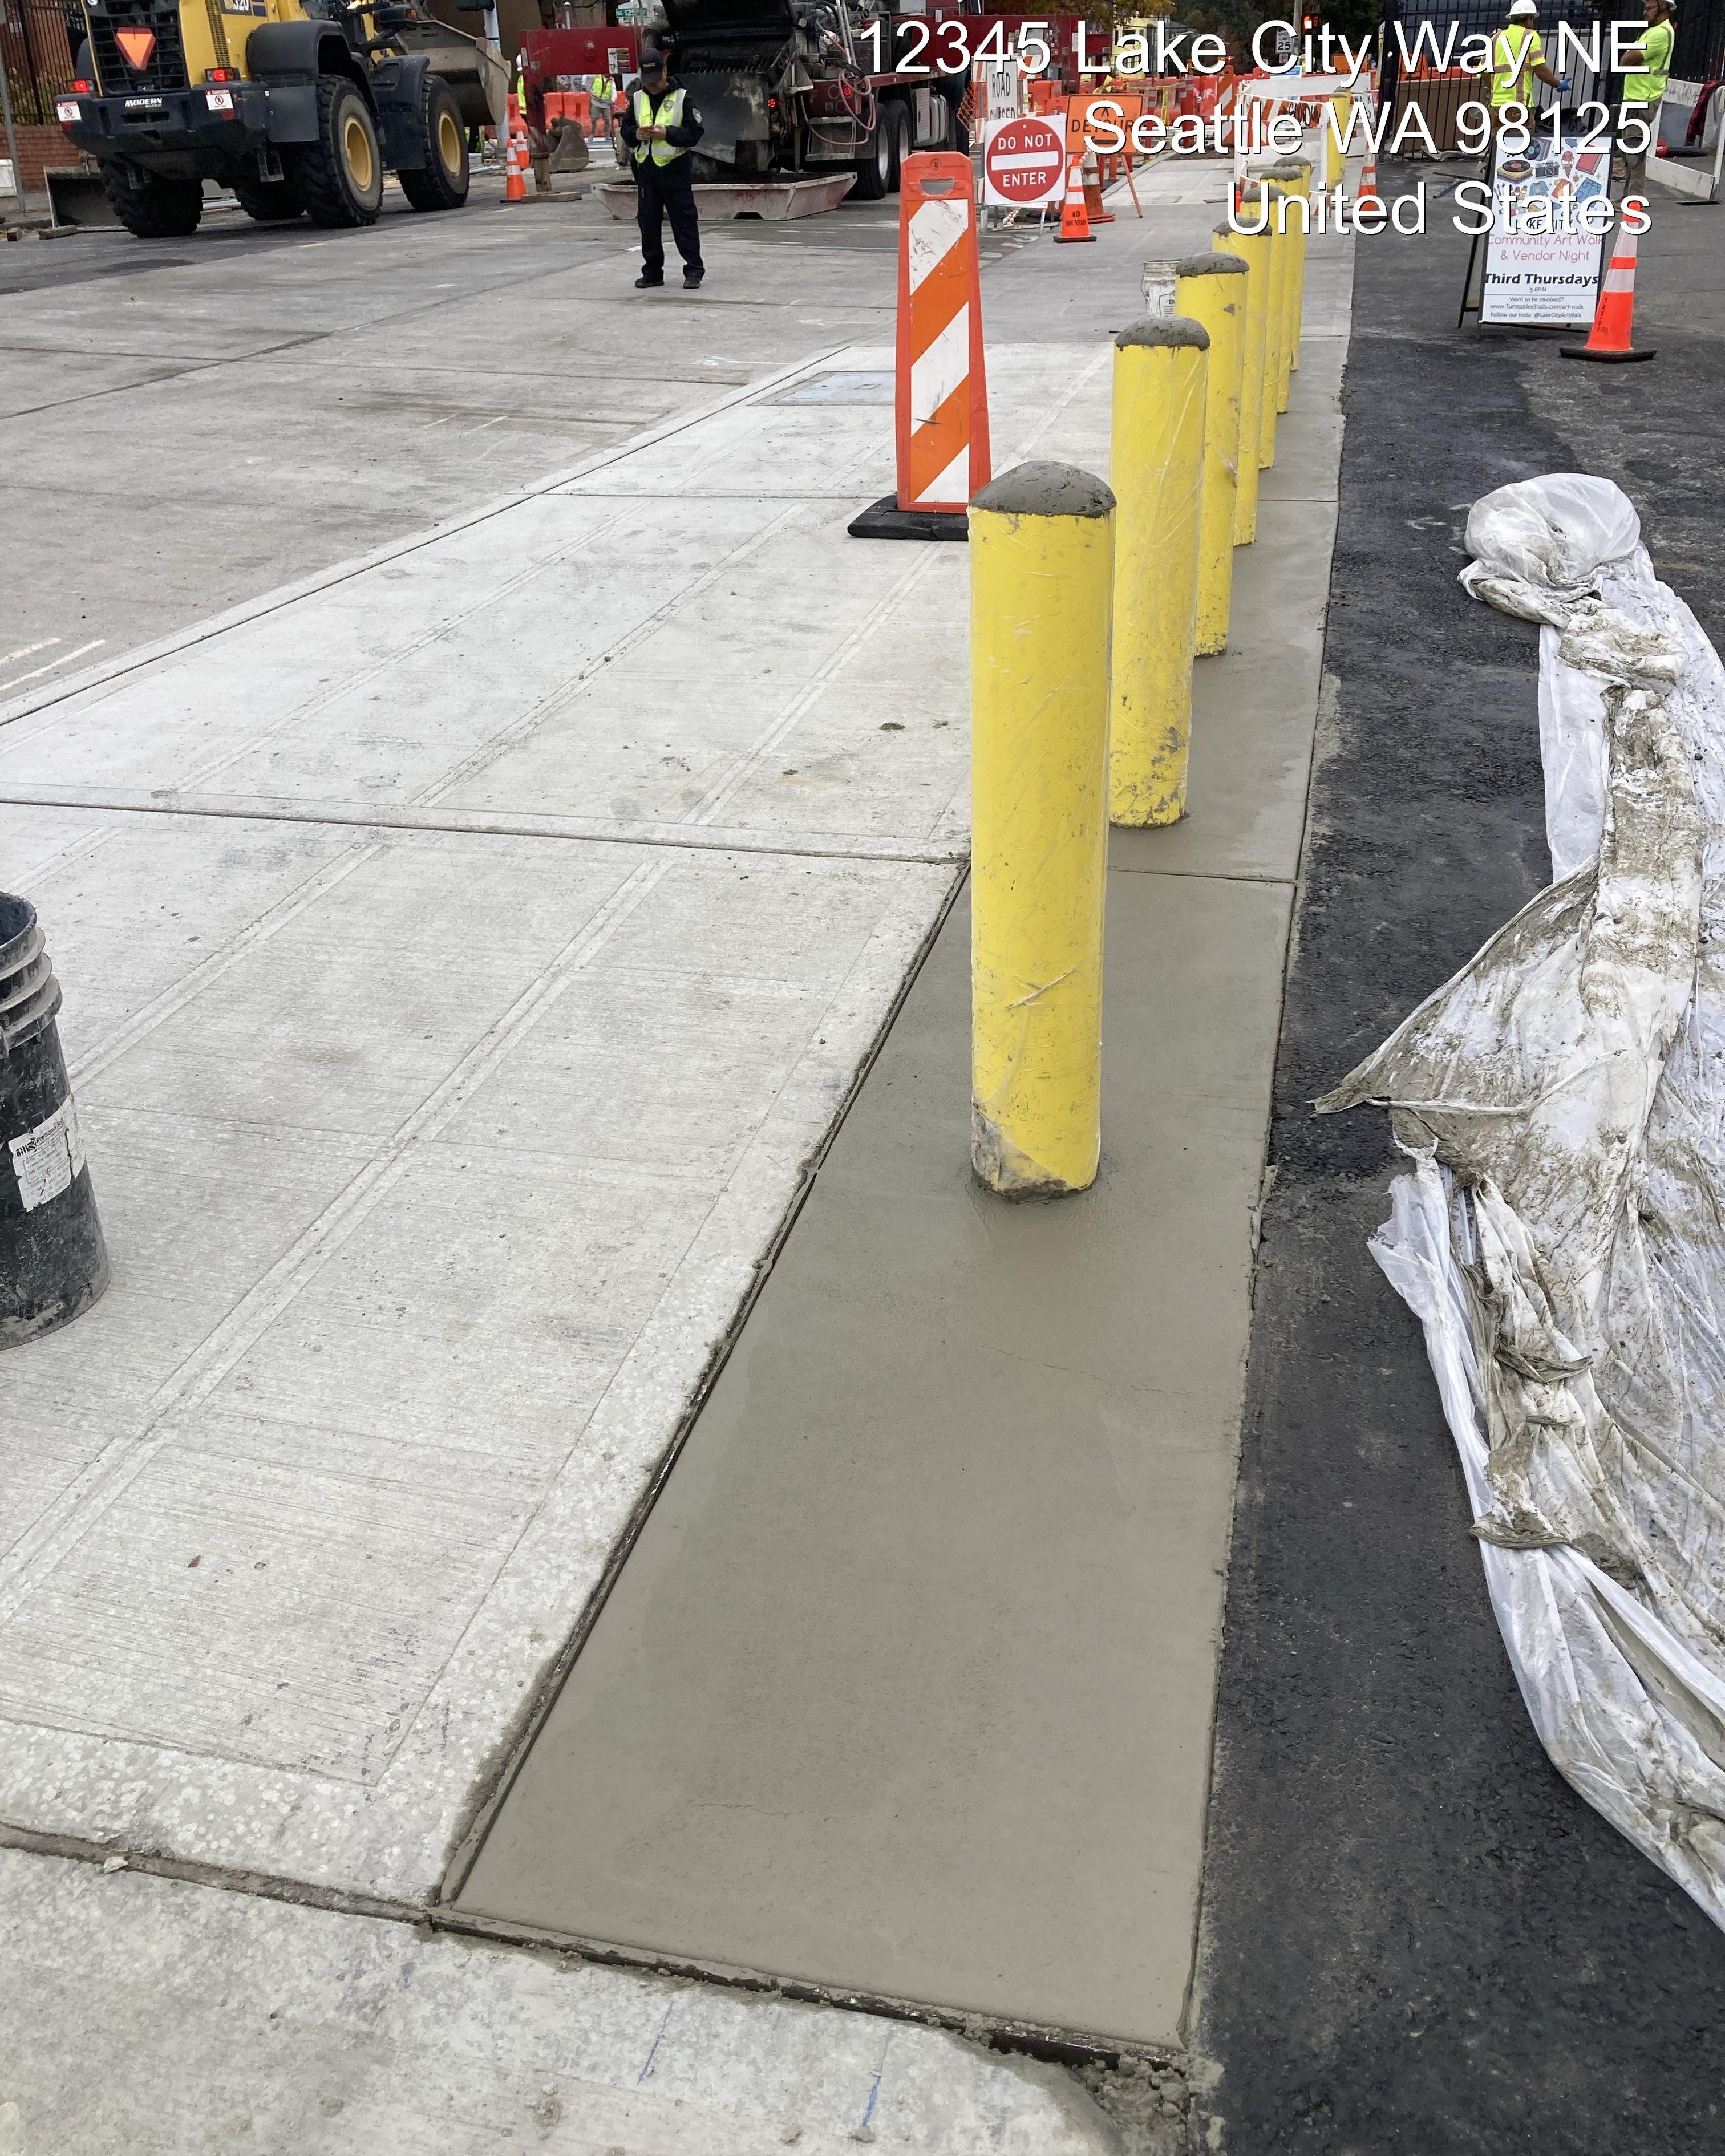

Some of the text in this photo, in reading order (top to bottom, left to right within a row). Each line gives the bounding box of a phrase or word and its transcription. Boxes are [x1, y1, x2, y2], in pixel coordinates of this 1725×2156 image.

[1278, 41, 1291, 51] 25
[992, 73, 1010, 98] ROAD
[125, 98, 163, 107] MODERN
[998, 133, 1052, 150] DO NOT
[1003, 171, 1046, 187] ENTER
[1515, 219, 1542, 230] LKE
[1488, 234, 1603, 248] Community Art Walk
[1500, 250, 1590, 264] & Vendor Night
[1485, 273, 1598, 287] Third Thursdays
